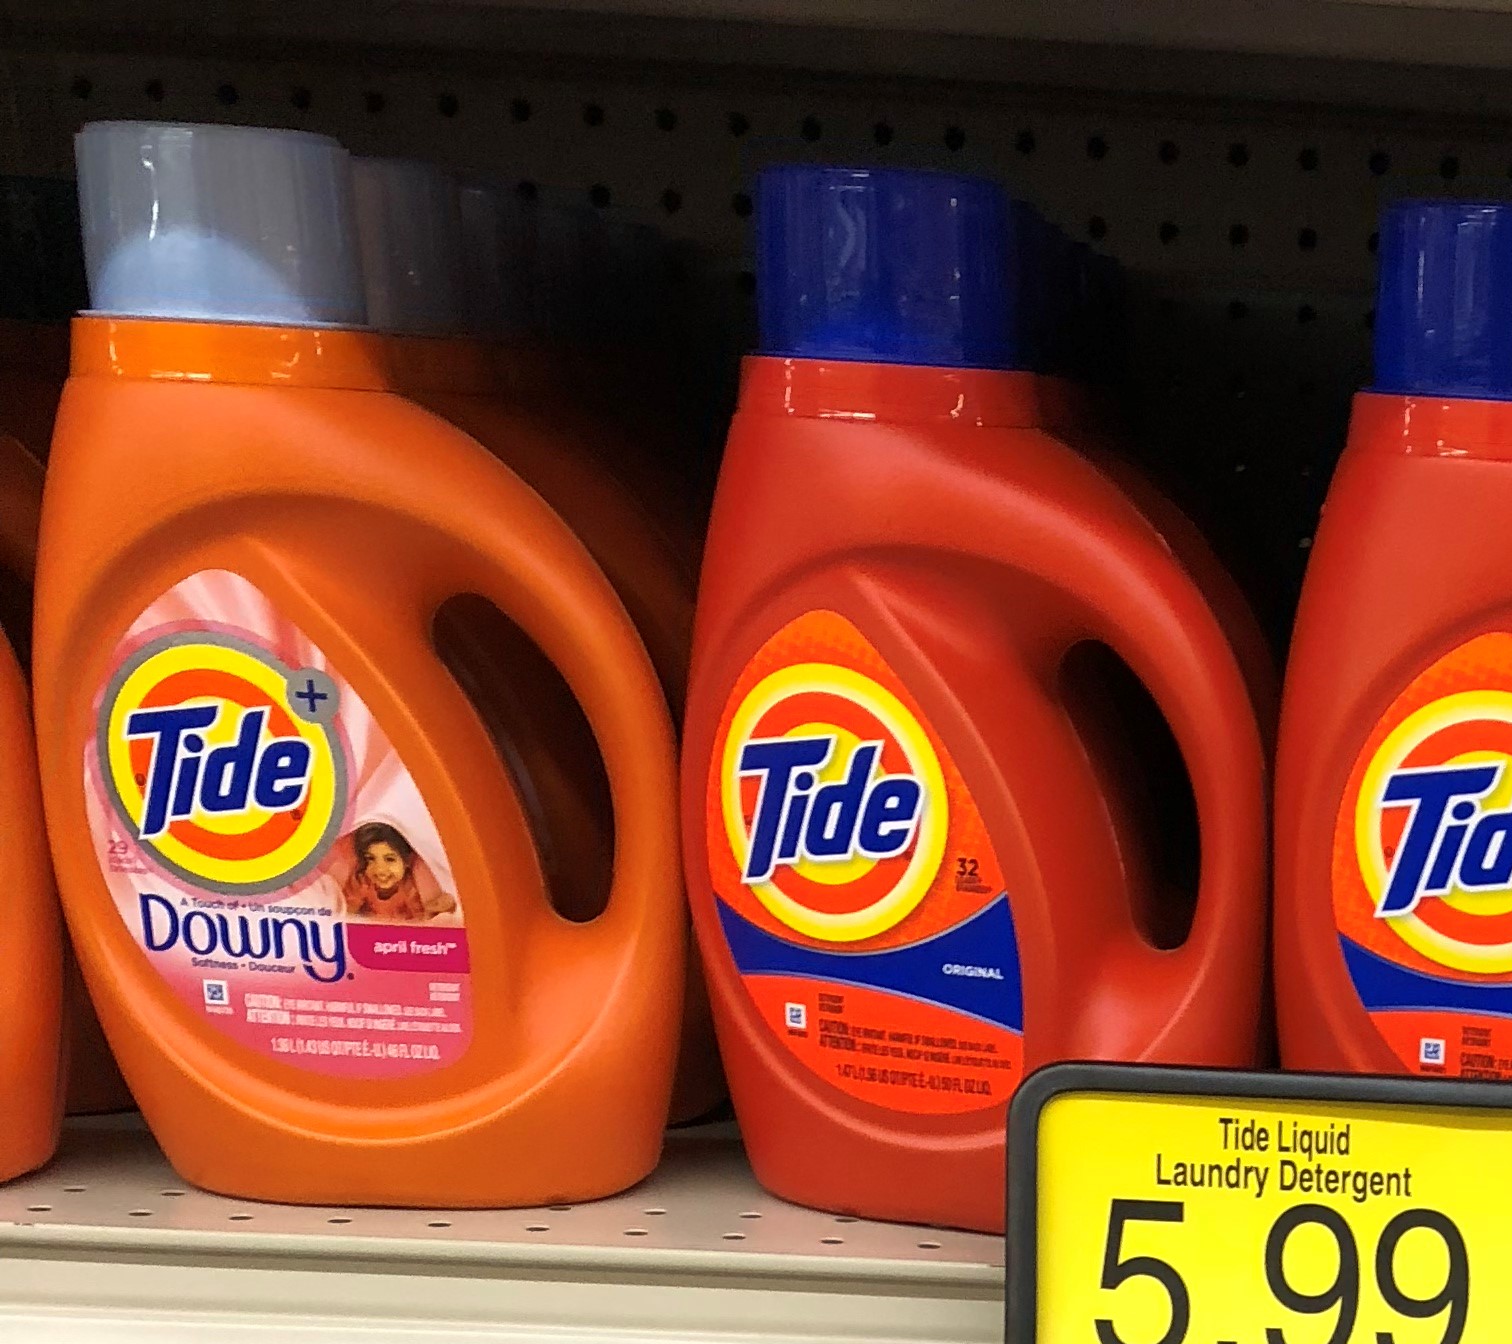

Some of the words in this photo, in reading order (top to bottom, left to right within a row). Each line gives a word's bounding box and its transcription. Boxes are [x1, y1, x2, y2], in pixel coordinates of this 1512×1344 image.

[124, 702, 314, 840] Tide
[738, 735, 925, 884] Tide
[957, 858, 979, 876] 32
[139, 892, 347, 984] Downy
[374, 941, 407, 956] april
[942, 963, 1004, 980] ORIGINAL
[1219, 1118, 1269, 1153] Tide
[1278, 1121, 1351, 1162] Liquid
[1156, 1153, 1269, 1198] Laundry
[1279, 1161, 1412, 1202] Detergent
